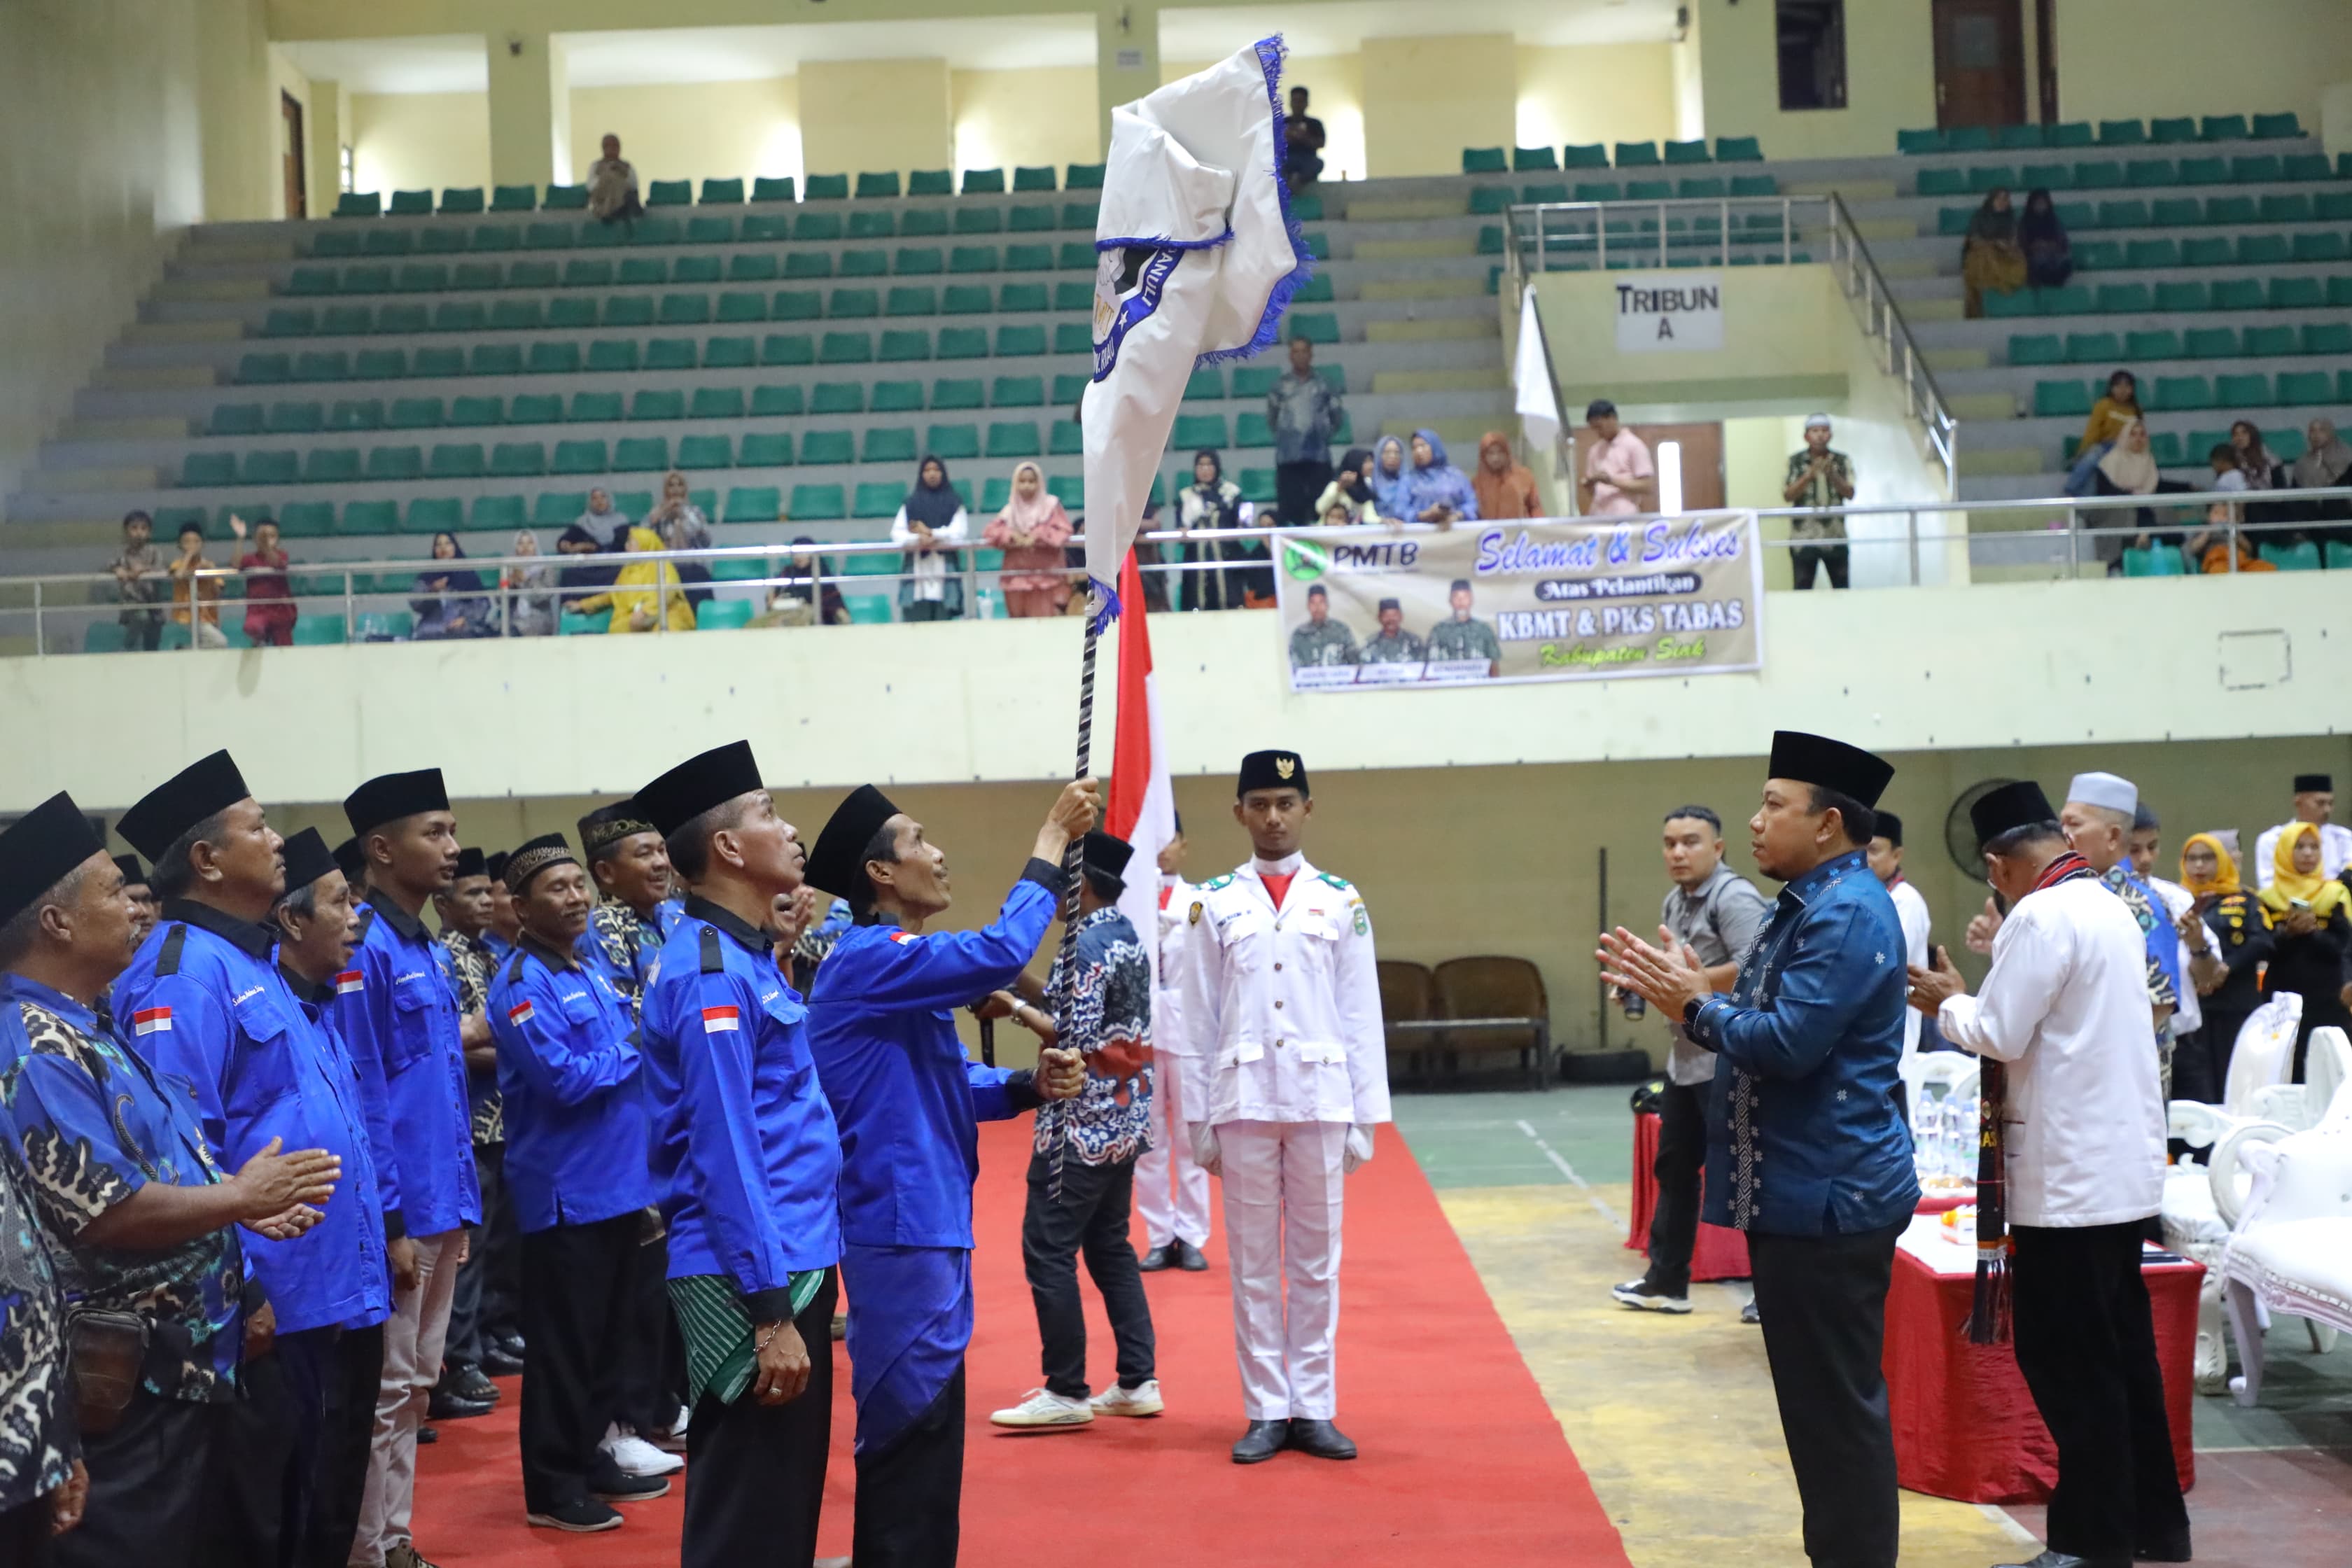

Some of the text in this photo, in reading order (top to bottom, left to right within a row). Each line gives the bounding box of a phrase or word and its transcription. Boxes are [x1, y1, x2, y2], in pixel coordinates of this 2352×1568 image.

[1142, 249, 1177, 307] ANULI
[1616, 284, 1719, 314] TRIBUN
[1657, 316, 1674, 341] A
[1101, 336, 1114, 372] RIAU
[1334, 542, 1419, 568] PMTB
[1476, 520, 1741, 572] Selamat & Sukses
[1543, 573, 1695, 598] Atas Pelantikan
[1498, 599, 1743, 640] KBMT & PKS TABAS
[1540, 643, 1648, 666] Kabupaten
